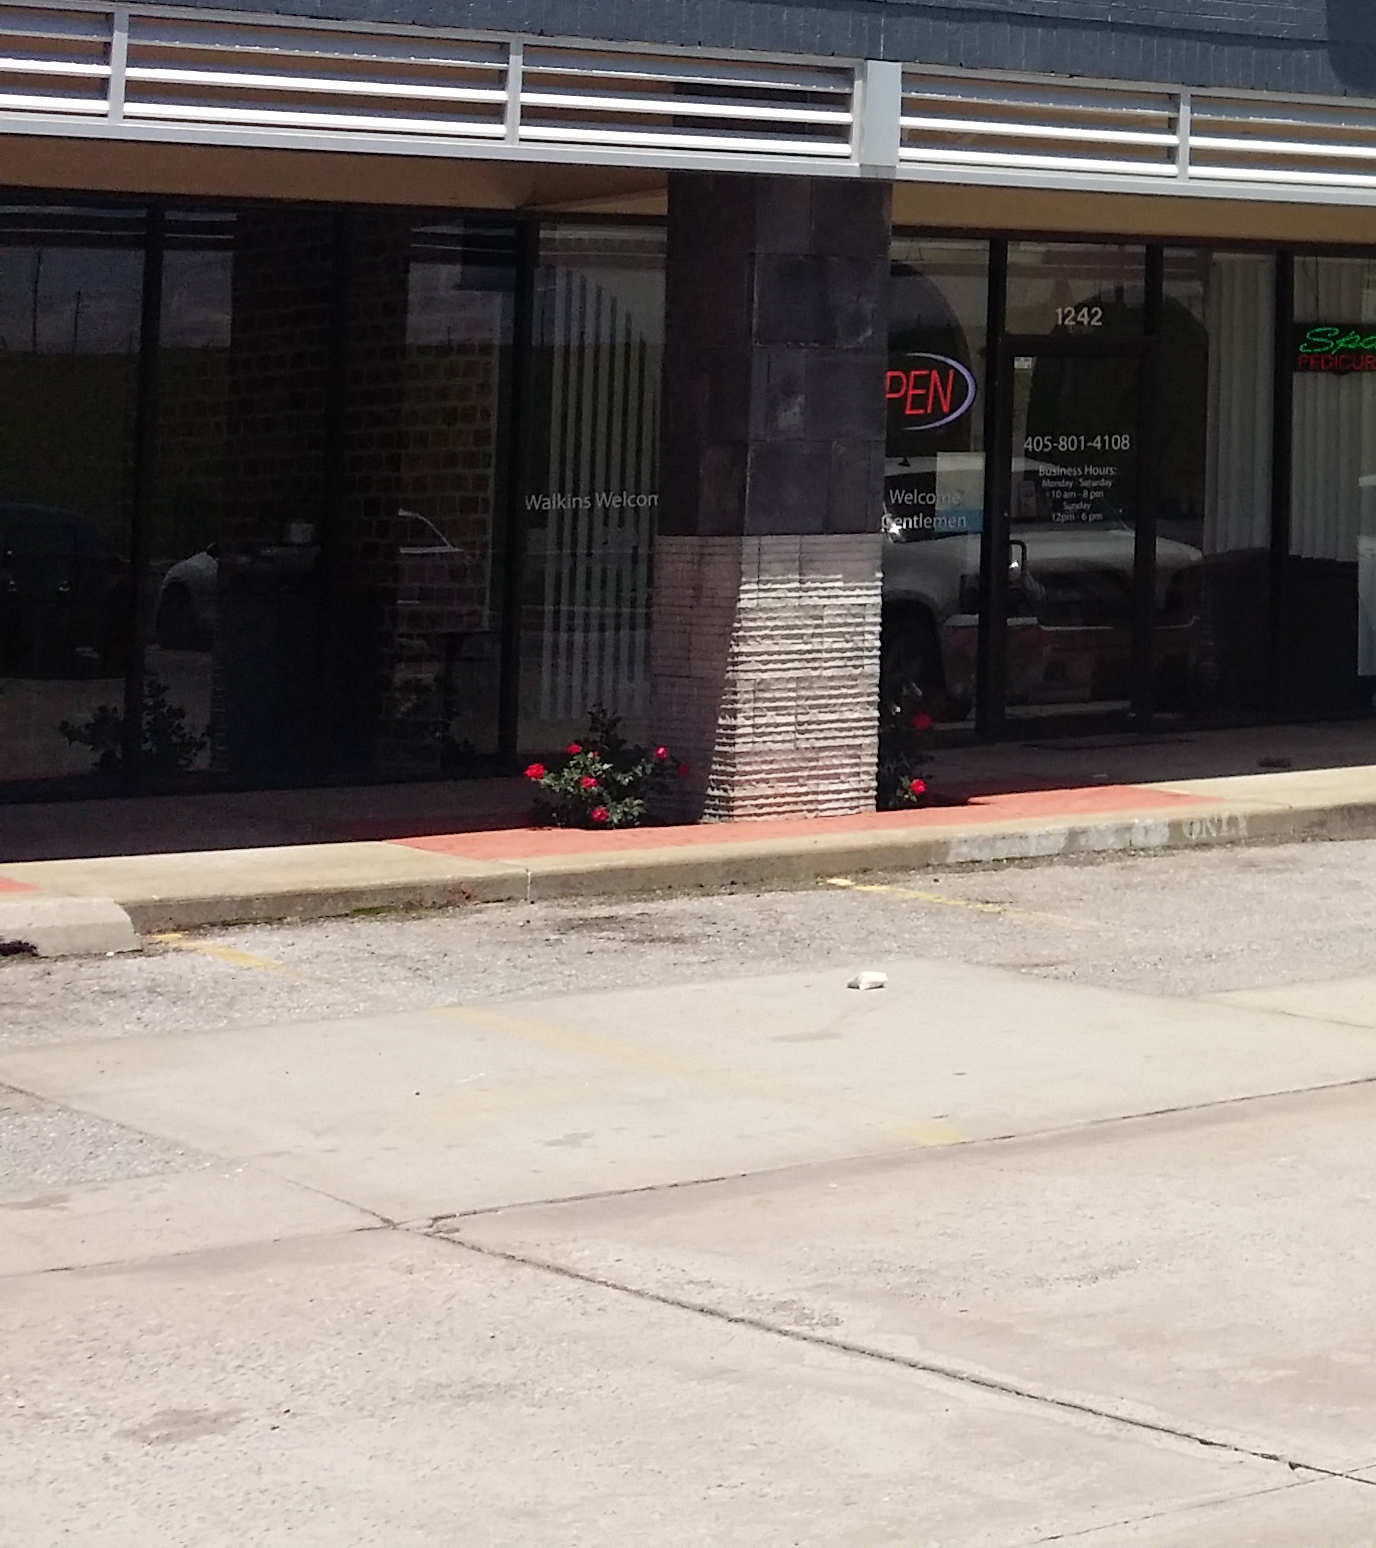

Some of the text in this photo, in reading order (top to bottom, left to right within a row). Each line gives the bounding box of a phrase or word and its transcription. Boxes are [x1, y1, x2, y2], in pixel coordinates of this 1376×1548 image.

[1055, 306, 1103, 326] 1242
[884, 369, 955, 415] PEN
[1023, 434, 1131, 452] 405-801-4108
[1039, 464, 1118, 477] Business Hours:
[1042, 479, 1074, 489] Monday
[525, 493, 592, 510] Walkins
[889, 488, 961, 505] Welcome
[1063, 501, 1092, 511] Sunday
[881, 512, 967, 529] Gentlemen
[1181, 812, 1248, 841] ONLY
